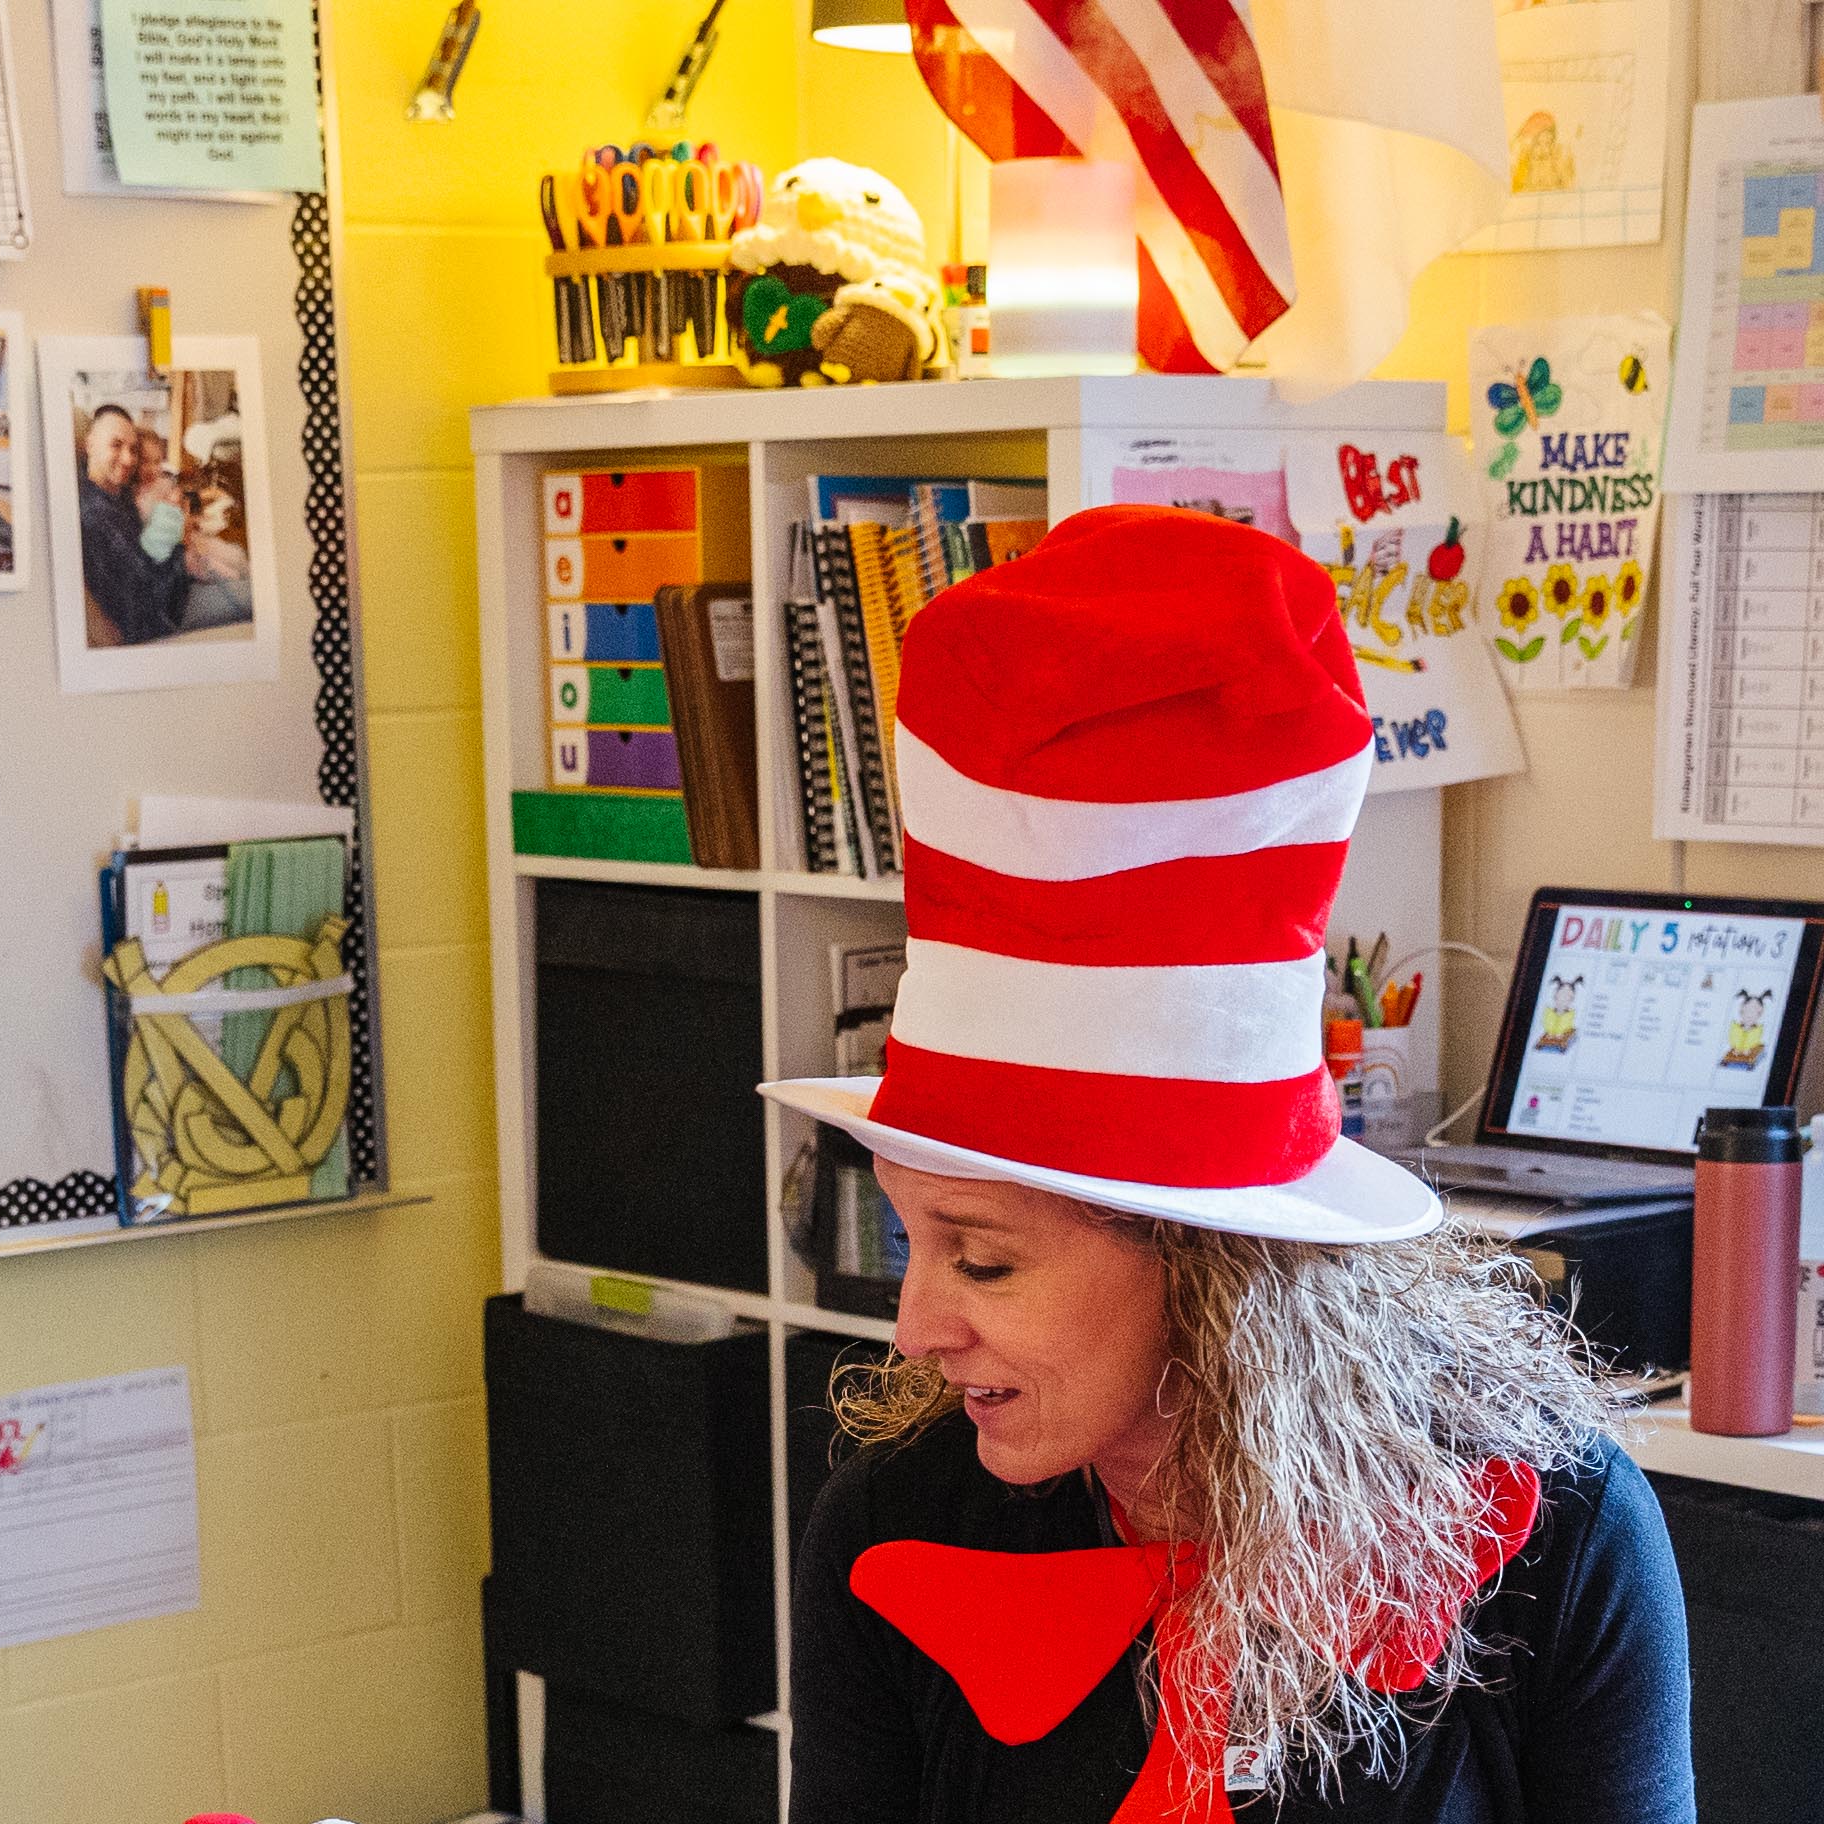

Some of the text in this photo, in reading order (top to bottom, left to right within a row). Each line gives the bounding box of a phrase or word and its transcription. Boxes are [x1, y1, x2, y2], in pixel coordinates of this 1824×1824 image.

[1541, 431, 1630, 471] MAKE
[1338, 443, 1422, 523] BEST
[1507, 473, 1654, 515] KINDNESS
[555, 491, 573, 519] a
[1525, 519, 1638, 565] A HABIT
[556, 556, 573, 585] e
[561, 683, 578, 710] o
[561, 743, 578, 771] u
[1560, 917, 1649, 953] DAILY
[1660, 922, 1679, 954] 5
